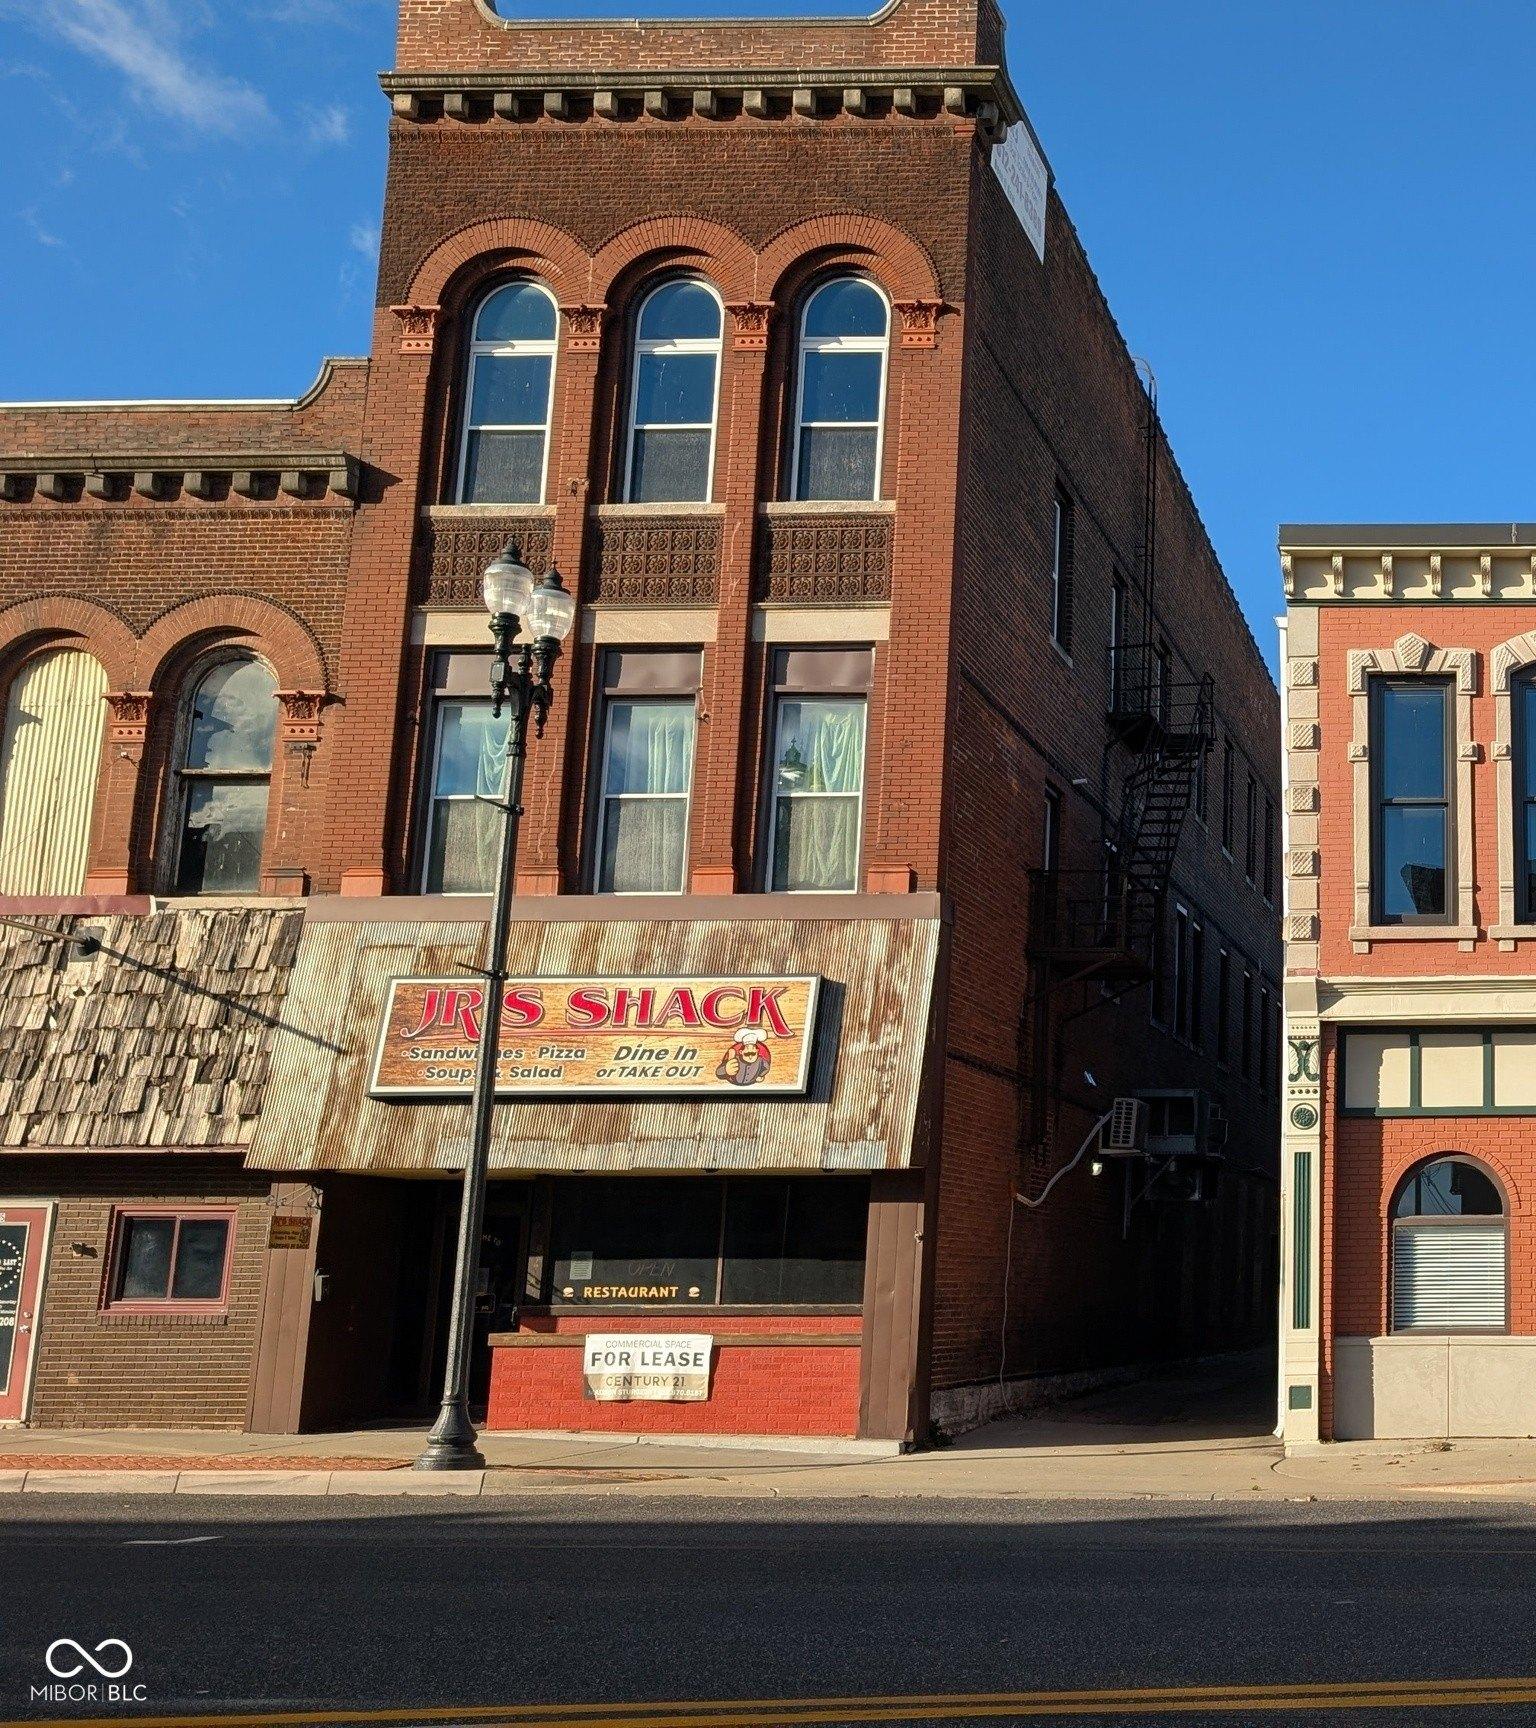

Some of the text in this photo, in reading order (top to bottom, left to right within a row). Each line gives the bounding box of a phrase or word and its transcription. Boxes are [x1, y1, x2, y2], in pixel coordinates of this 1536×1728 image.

[567, 985, 794, 1039] SHACK
[538, 1046, 586, 1060] Pizza
[614, 1045, 698, 1061] Dine In
[510, 1066, 563, 1079] Salad
[596, 1066, 702, 1078] or TAKE OUT
[583, 1287, 679, 1298] RESTAURANT
[605, 1340, 692, 1349] COMMERCIAL SPACE
[591, 1352, 704, 1367] FOR LEASE
[605, 1376, 669, 1387] CENTURY
